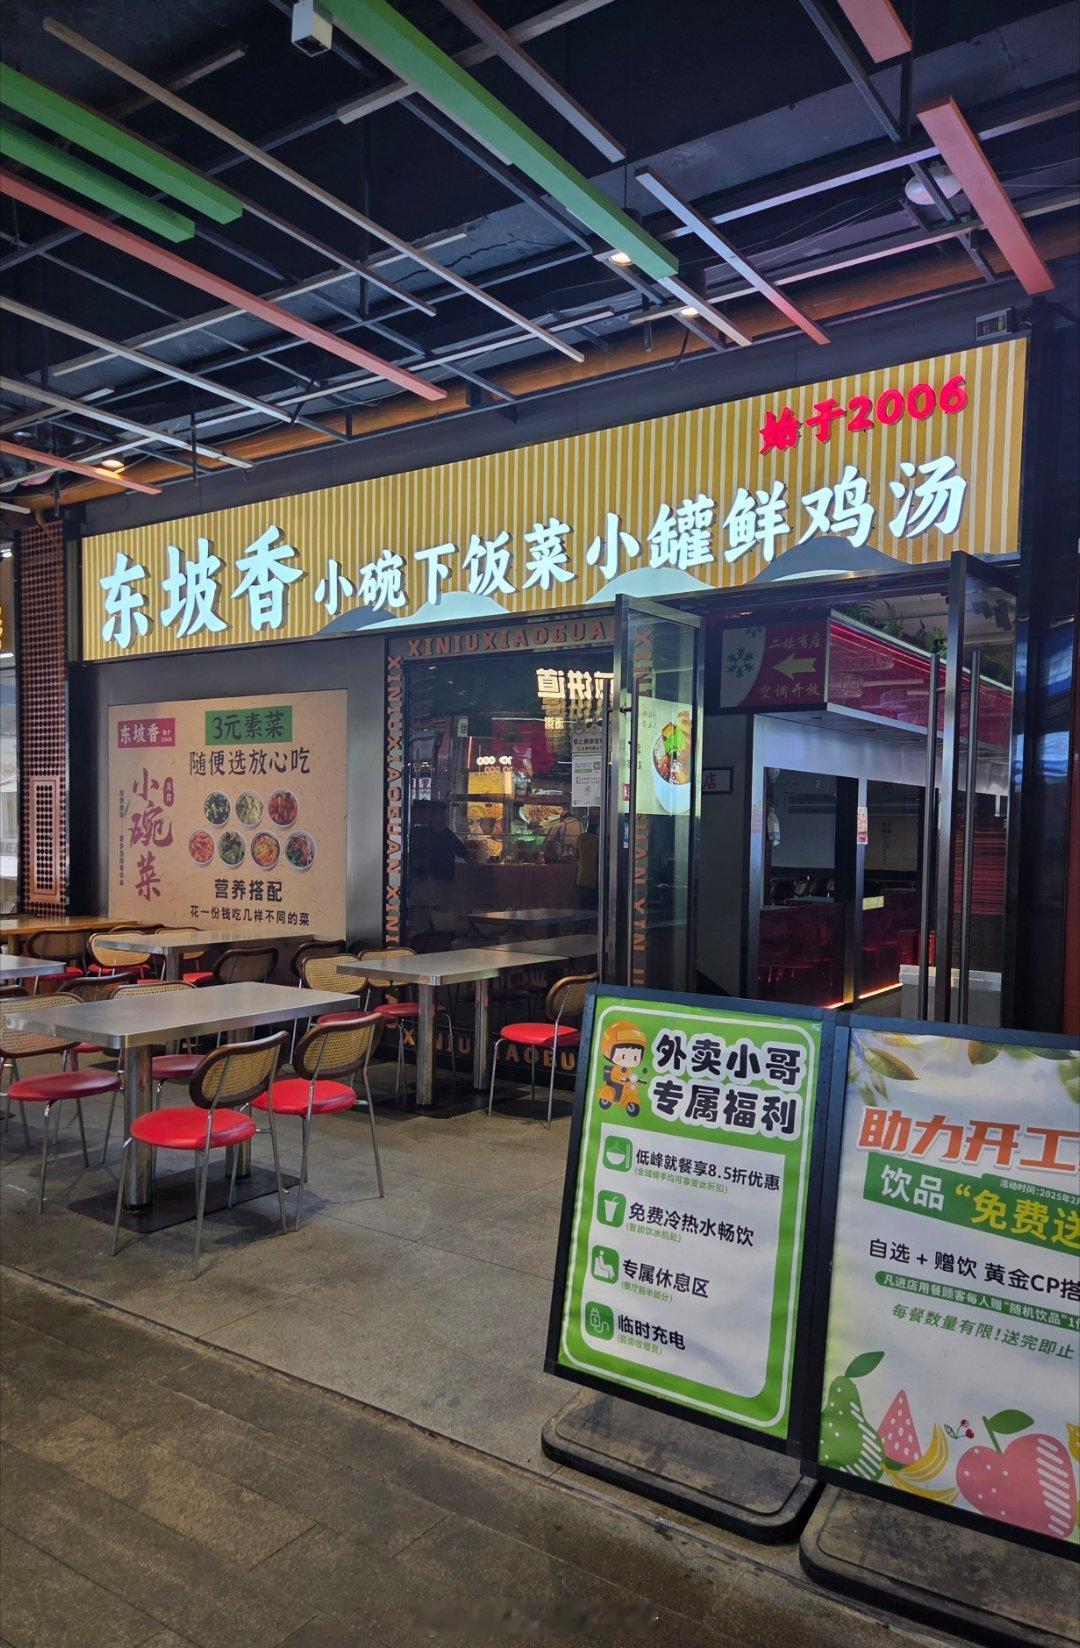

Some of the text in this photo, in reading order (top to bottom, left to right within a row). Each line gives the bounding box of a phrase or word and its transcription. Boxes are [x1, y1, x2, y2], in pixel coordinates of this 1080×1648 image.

[759, 375, 969, 455] 始于2006
[100, 524, 306, 649] 东坡香
[407, 620, 616, 657] XINIUXIAOGUA
[120, 723, 160, 745] 东坡香
[213, 711, 284, 740] 3元素菜
[189, 747, 311, 776] 随便选放心吃
[214, 878, 283, 902] 营养搭配
[189, 904, 310, 926] 花一份钱吃几样不同的菜
[656, 1034, 801, 1086] 外卖小哥
[652, 1080, 798, 1135] 专属福利
[857, 1106, 1080, 1173] 助力开工
[635, 1149, 781, 1190] 低峰就餐享8.5折优惠
[880, 1164, 946, 1213] 饮品
[628, 1202, 755, 1247] 免费冷热水畅饮
[622, 1258, 710, 1299] 专属休息区
[617, 1314, 686, 1351] 临时充电
[891, 1303, 1075, 1360] 每餐数量有限!送完即止
